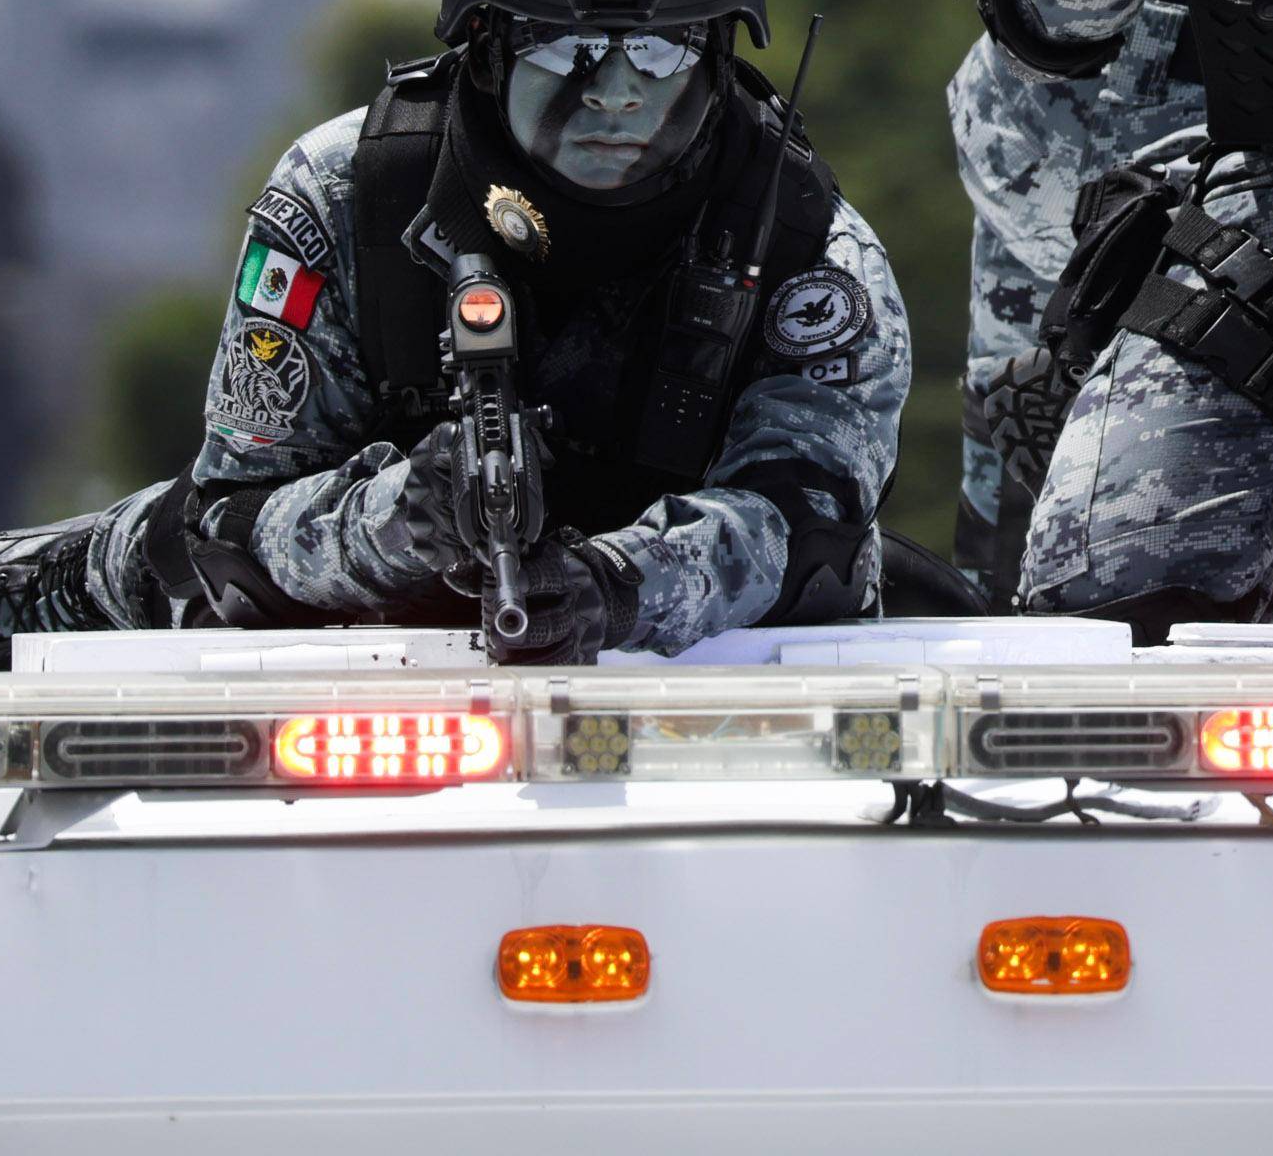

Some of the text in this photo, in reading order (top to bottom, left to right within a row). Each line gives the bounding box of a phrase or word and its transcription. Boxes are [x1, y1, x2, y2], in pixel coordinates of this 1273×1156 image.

[254, 194, 327, 263] MEXICO
[810, 364, 842, 380] O+
[223, 400, 284, 426] LOBOS
